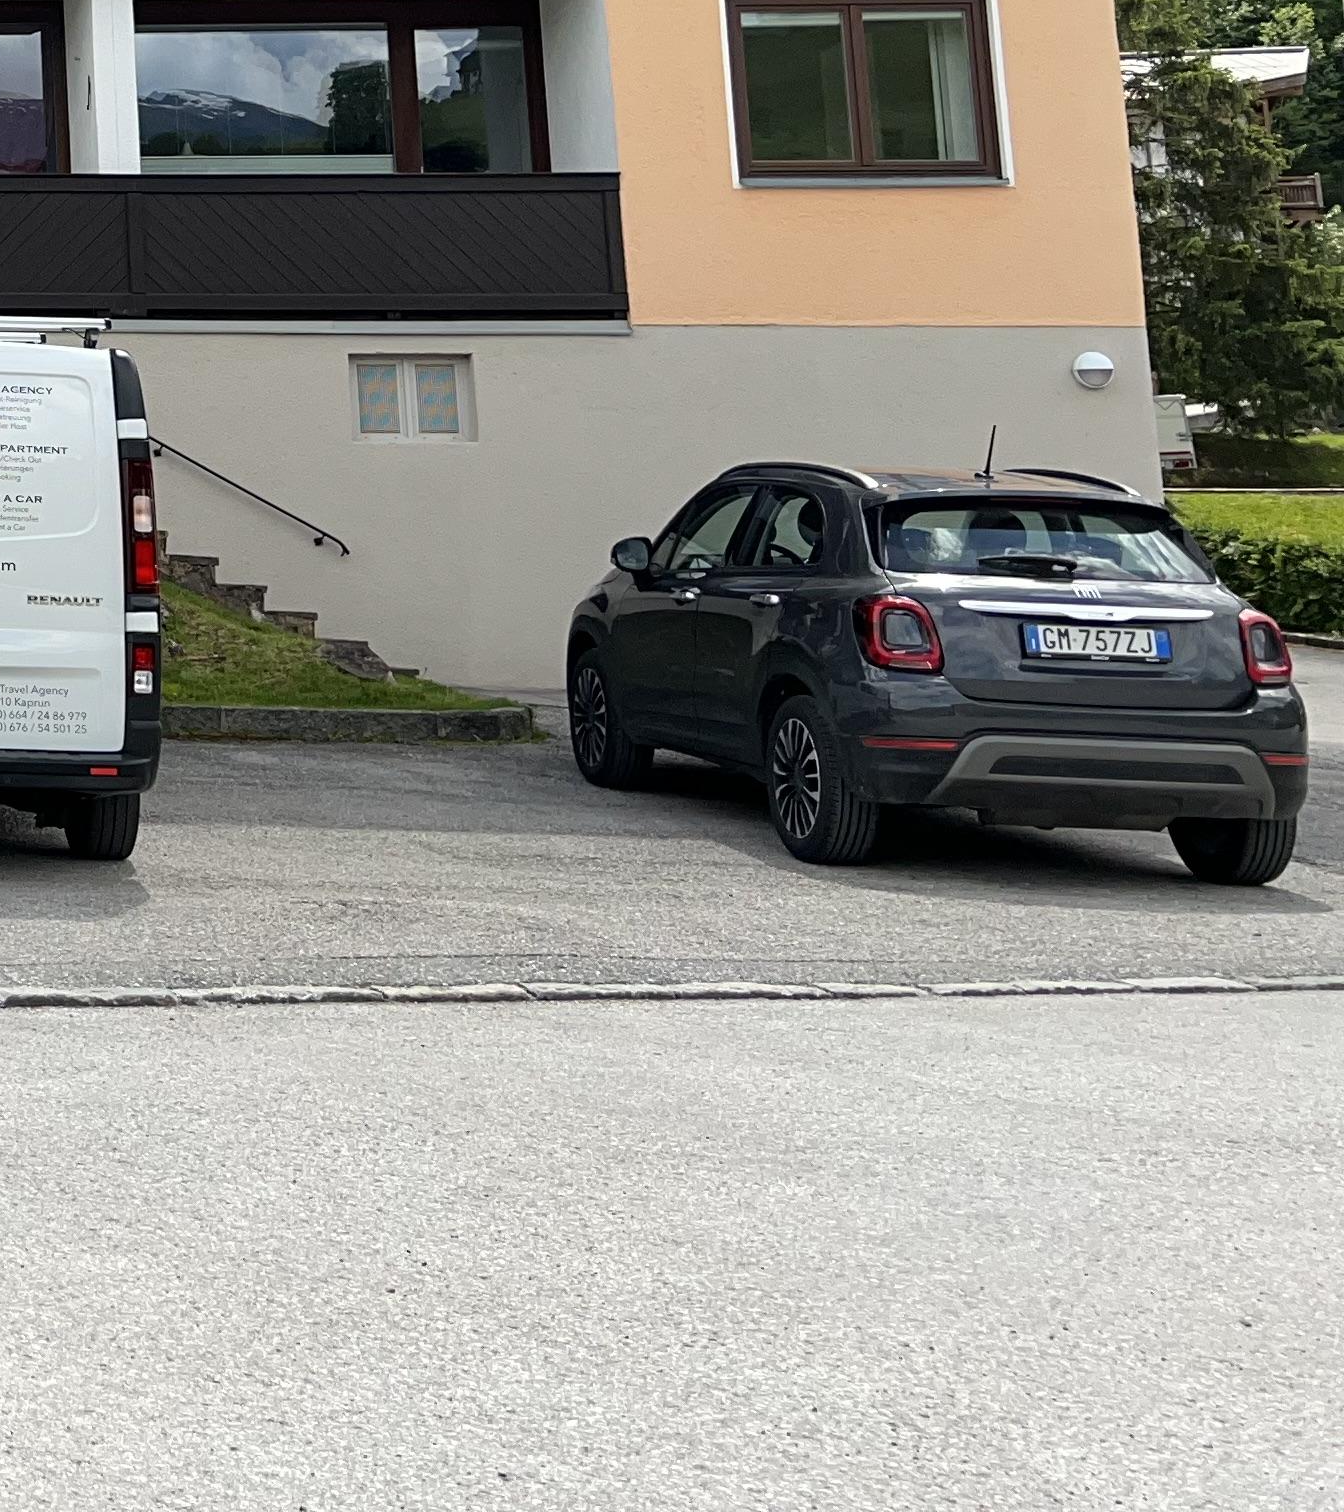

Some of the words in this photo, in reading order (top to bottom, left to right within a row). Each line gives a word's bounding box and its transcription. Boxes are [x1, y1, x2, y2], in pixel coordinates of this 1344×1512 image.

[2, 385, 53, 395] AGENCY
[3, 494, 12, 502] A
[15, 495, 42, 504] CAR
[27, 595, 103, 607] RENAULT
[1042, 627, 1071, 650] GM
[1079, 629, 1153, 654] 757ZJ
[0, 684, 29, 694] Travel
[31, 685, 69, 697] Agency
[14, 698, 50, 708] Kaprun
[9, 710, 28, 719] 664
[30, 710, 35, 719] /
[37, 711, 50, 720] 24
[52, 712, 65, 721] 86
[68, 712, 87, 721] 979
[9, 722, 28, 732] 676
[30, 723, 35, 732] /
[37, 724, 50, 733] 54
[53, 724, 71, 733] 501
[74, 725, 88, 734] 25
